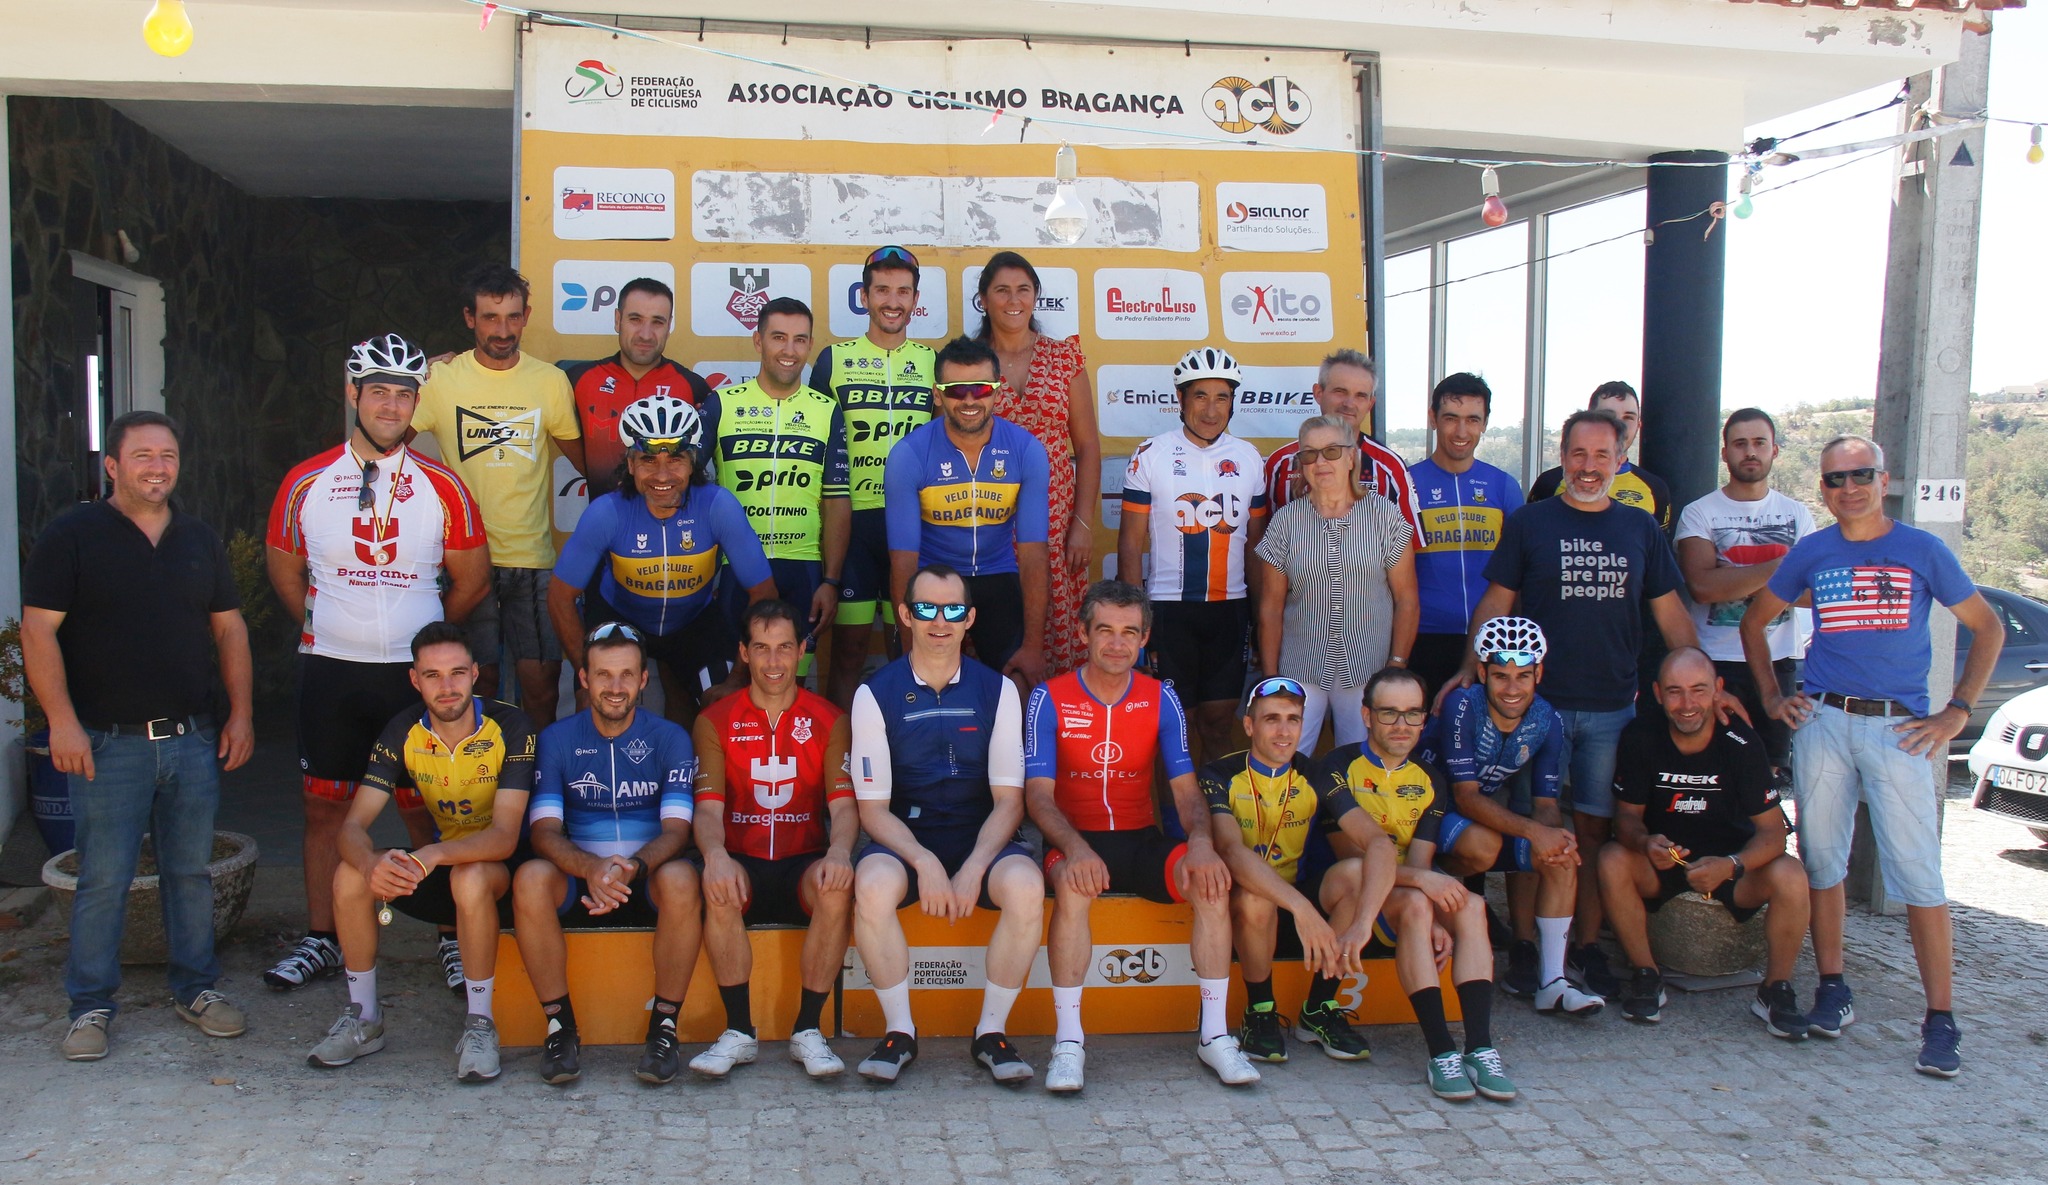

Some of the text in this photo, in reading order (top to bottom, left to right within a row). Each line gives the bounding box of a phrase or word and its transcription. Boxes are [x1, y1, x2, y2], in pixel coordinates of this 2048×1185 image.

[631, 76, 693, 86] FEDERAÇÃO
[631, 88, 702, 98] PORTUGUESA
[631, 99, 697, 108] DE CICLISMO
[727, 83, 1184, 118] ASSOCIAÇÃO CICLISMO BRAGANÇA
[597, 192, 665, 204] RECONCO
[1226, 225, 1273, 233] Partilhando
[1037, 297, 1064, 308] TEK
[656, 385, 671, 397] 17
[847, 390, 929, 406] BBIKE
[1240, 391, 1314, 405] BBIKE
[732, 440, 816, 456] BBIKE
[756, 465, 810, 491] prio
[945, 489, 1002, 504] VELO CLUBE
[1920, 485, 1961, 501] 246
[932, 507, 1011, 521] BRAGANÇA
[1435, 512, 1486, 524] VELO CLUBE
[1425, 529, 1495, 545] BRAGANÇA
[1560, 538, 1603, 553] bike
[1561, 553, 1628, 570] people
[337, 568, 418, 580] Bragança
[637, 562, 694, 576] VELO CLUBE
[625, 575, 703, 591] BRAGANÇA
[1561, 570, 1628, 586] are my
[1561, 583, 1625, 601] people
[1133, 701, 1149, 709] PACTO
[1081, 709, 1094, 718] TEAM
[1168, 688, 1188, 748] SANIPOWER
[1026, 692, 1040, 753] SANIPOWER
[1453, 697, 1469, 749] BOLFLEX
[729, 734, 765, 743] TREK
[1069, 732, 1092, 740] catlike
[1070, 769, 1138, 779] PROTEU
[1658, 772, 1719, 785] TREK
[616, 781, 659, 799] AMP
[438, 798, 473, 816] MS
[731, 811, 811, 827] Bragança
[914, 961, 962, 970] FEDERAÇÃO
[913, 977, 965, 985] DE CICLISMO
